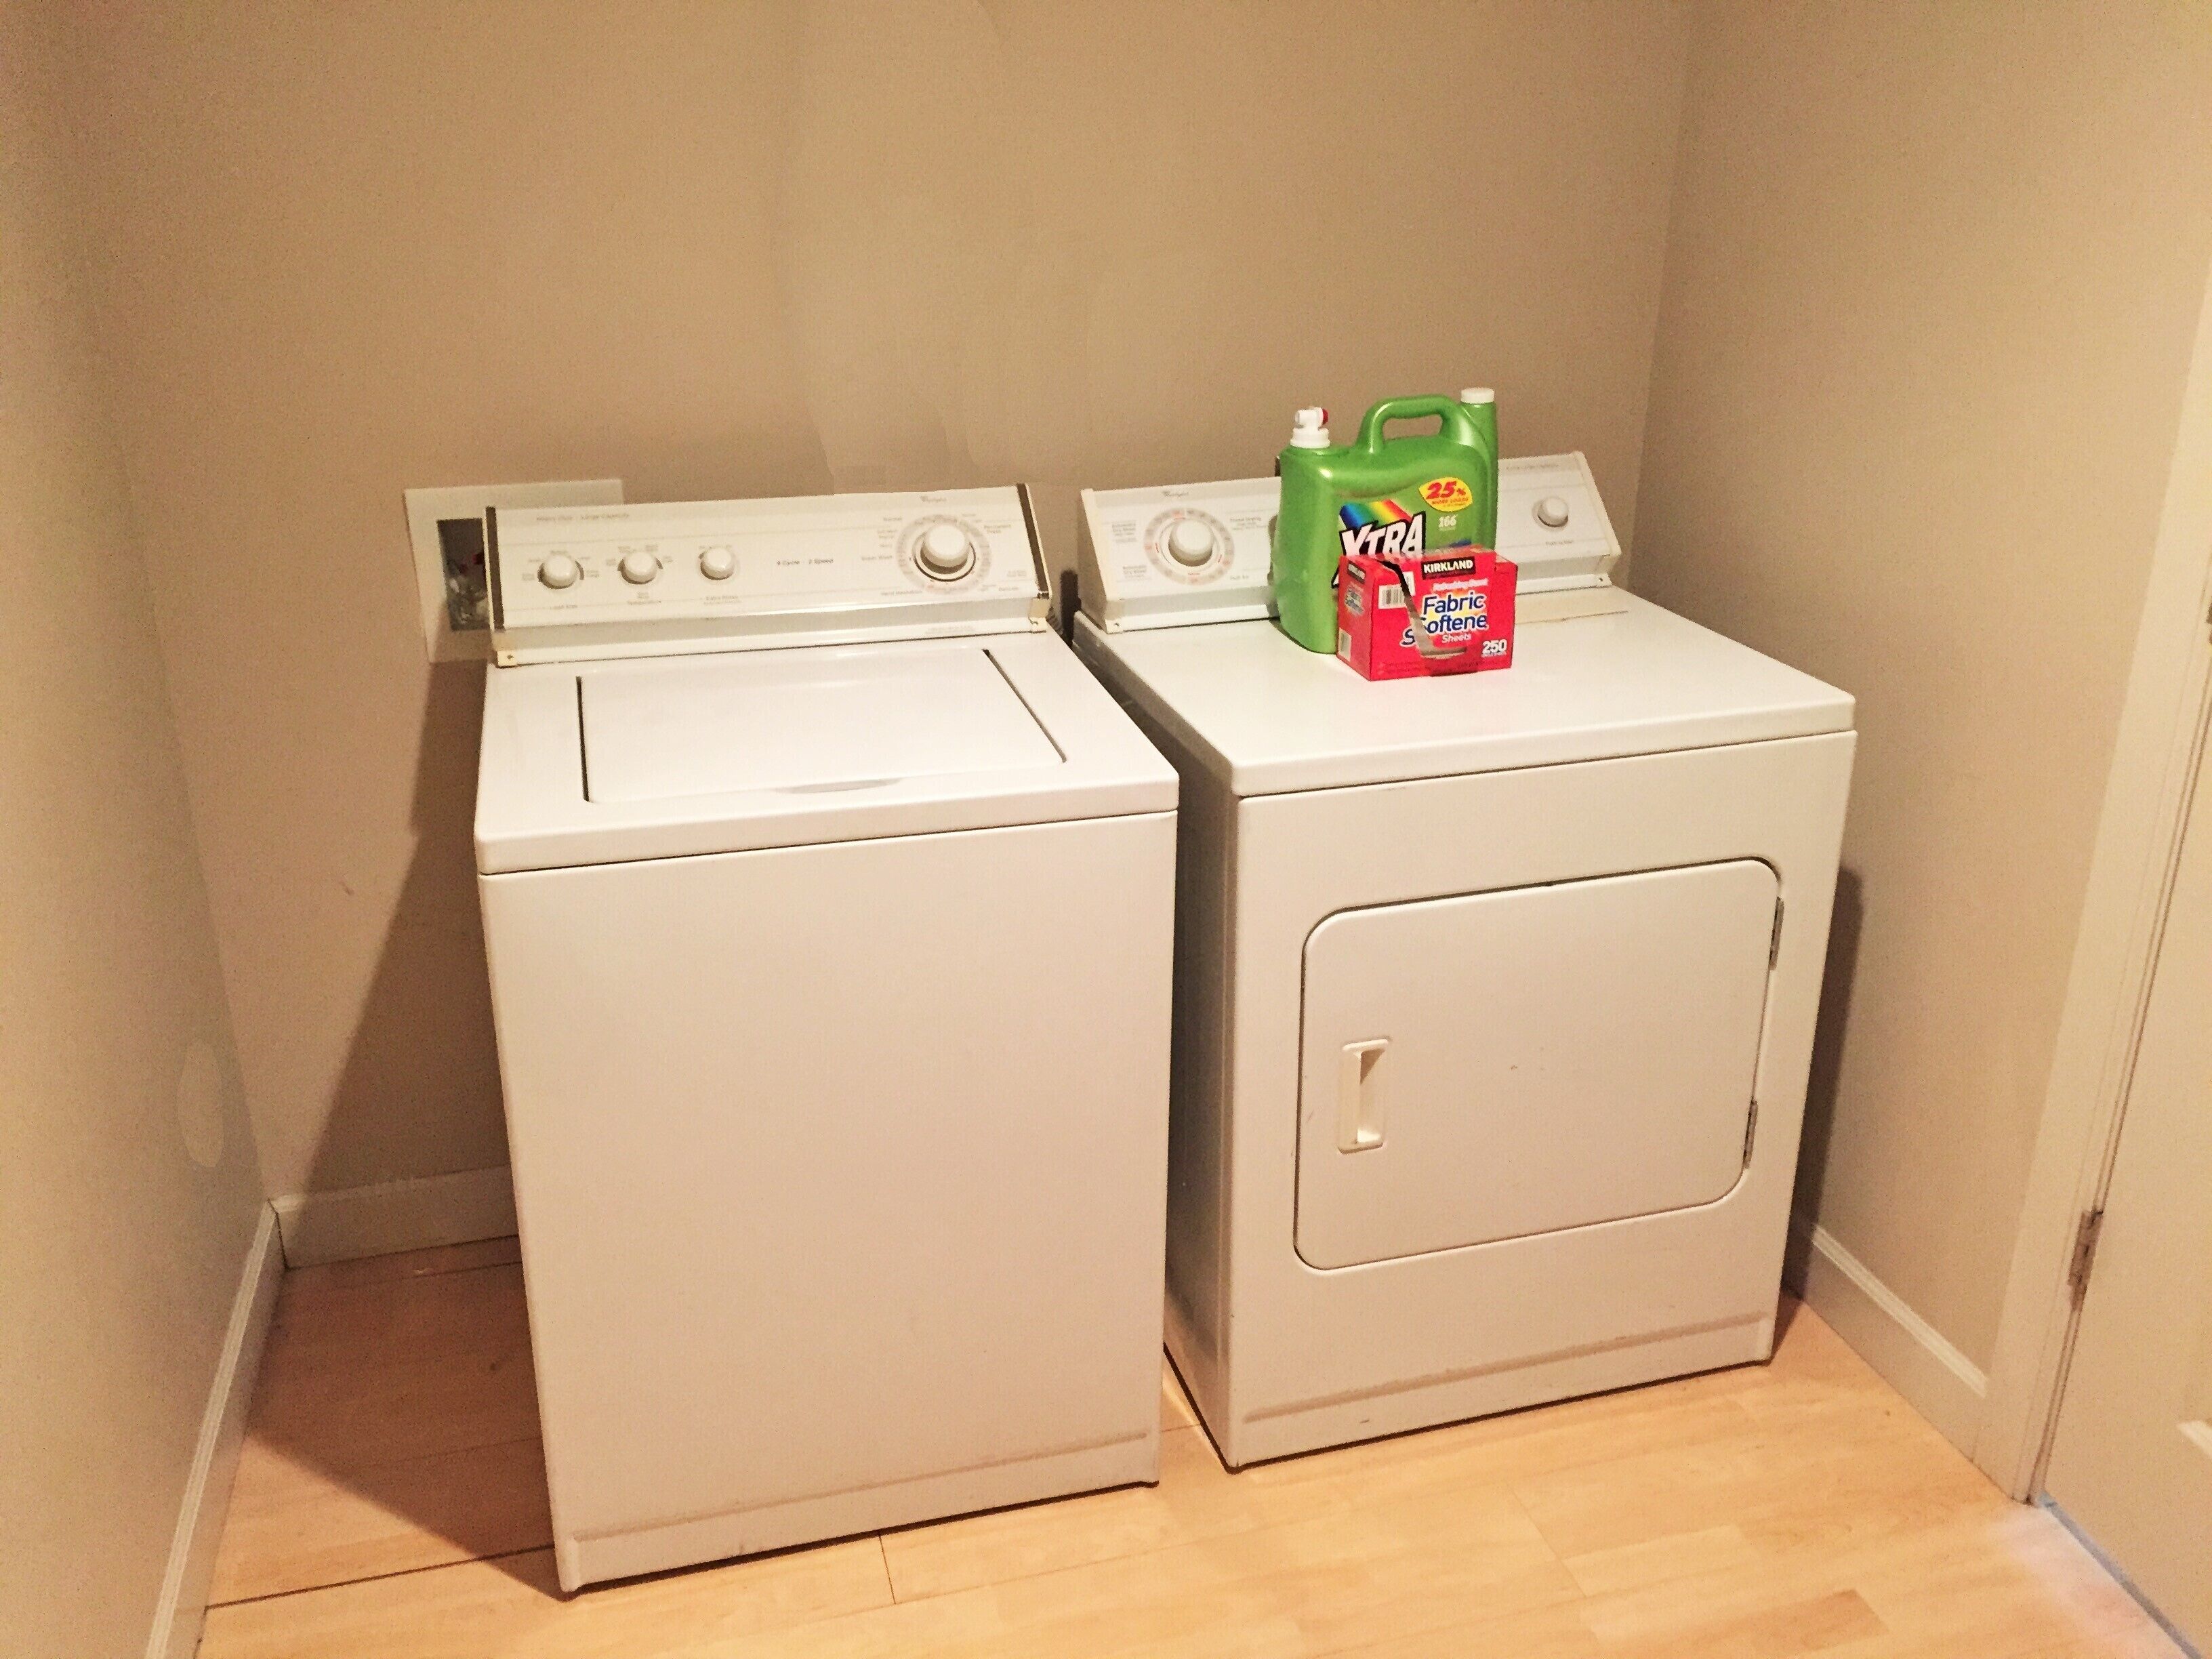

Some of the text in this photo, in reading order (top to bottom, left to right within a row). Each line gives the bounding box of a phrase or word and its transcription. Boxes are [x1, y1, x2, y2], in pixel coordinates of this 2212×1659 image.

[1426, 480, 1467, 499] 25%
[1423, 559, 1475, 573] KIRKLAND
[1422, 591, 1486, 615] Fabric
[1441, 633, 1472, 644] Sheets
[1481, 639, 1509, 655] 250
